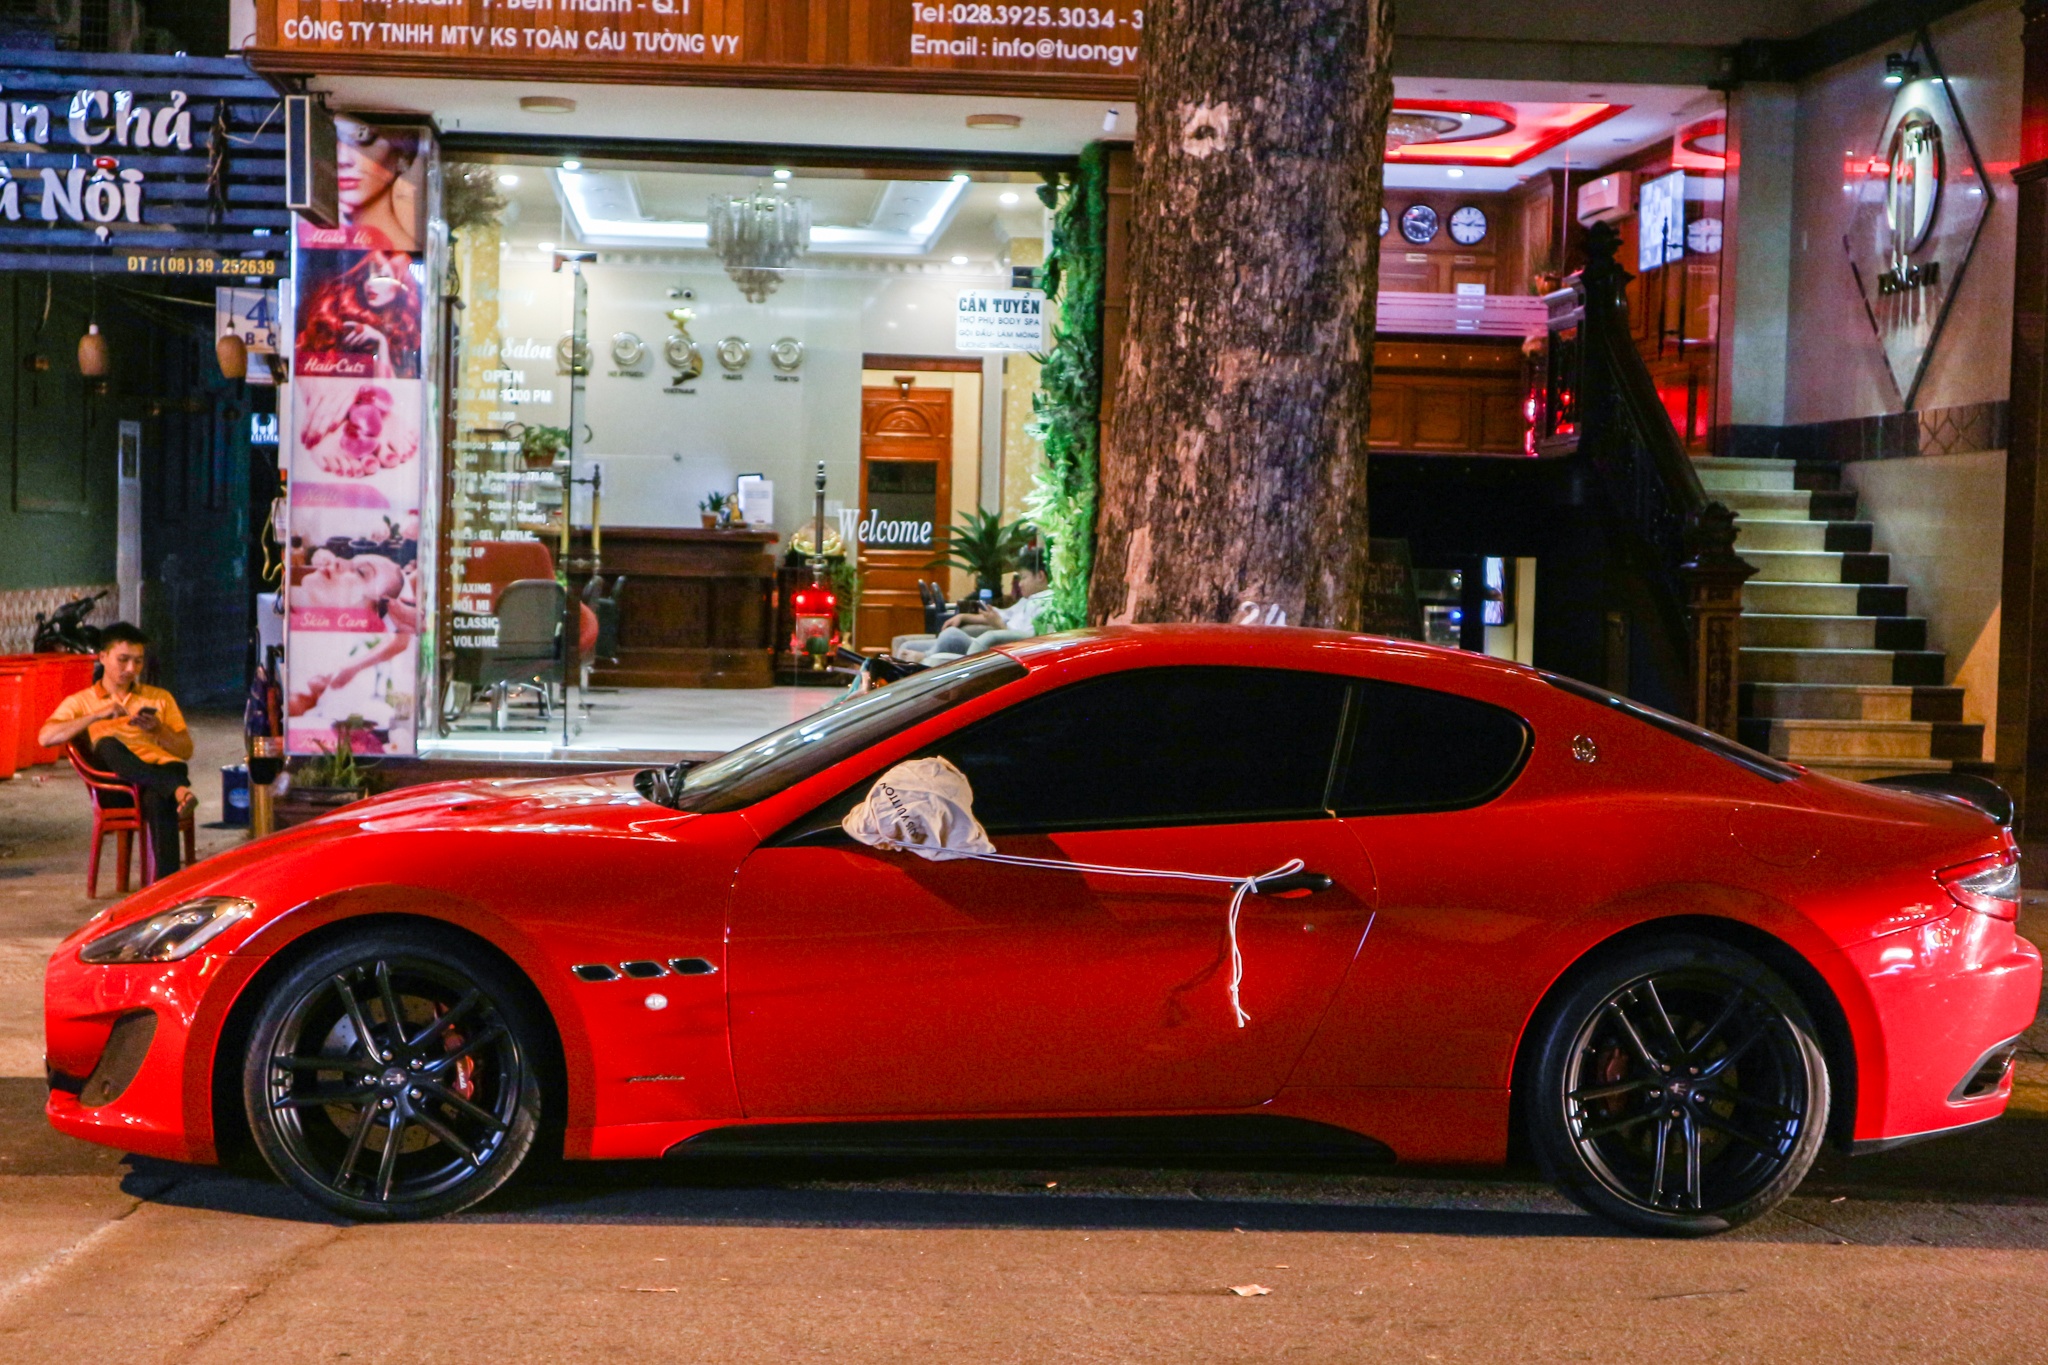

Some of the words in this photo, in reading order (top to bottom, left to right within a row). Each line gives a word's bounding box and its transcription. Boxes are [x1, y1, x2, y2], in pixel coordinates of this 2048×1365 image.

[283, 14, 344, 41] CÔNG
[349, 21, 375, 42] TY
[379, 22, 434, 44] TNHH
[441, 25, 484, 46] MTV
[490, 27, 518, 47] KS
[522, 25, 579, 50] TOÀN
[632, 28, 705, 54] TƯỜNG
[711, 34, 741, 55] VY
[68, 88, 193, 151] Chả
[39, 165, 145, 243] Nội
[998, 316, 1022, 325] BODY
[1024, 317, 1041, 327] SPA
[500, 337, 553, 359] Salon
[304, 357, 366, 374] HairCuts
[482, 369, 525, 384] OPEN
[533, 389, 553, 402] PM
[837, 508, 933, 544] Welcome
[474, 546, 486, 558] UP
[453, 583, 493, 594] WAXING
[299, 611, 330, 628] Skin
[337, 612, 369, 628] Care
[453, 616, 500, 630] CLASSIC
[452, 635, 499, 649] VOLUME
